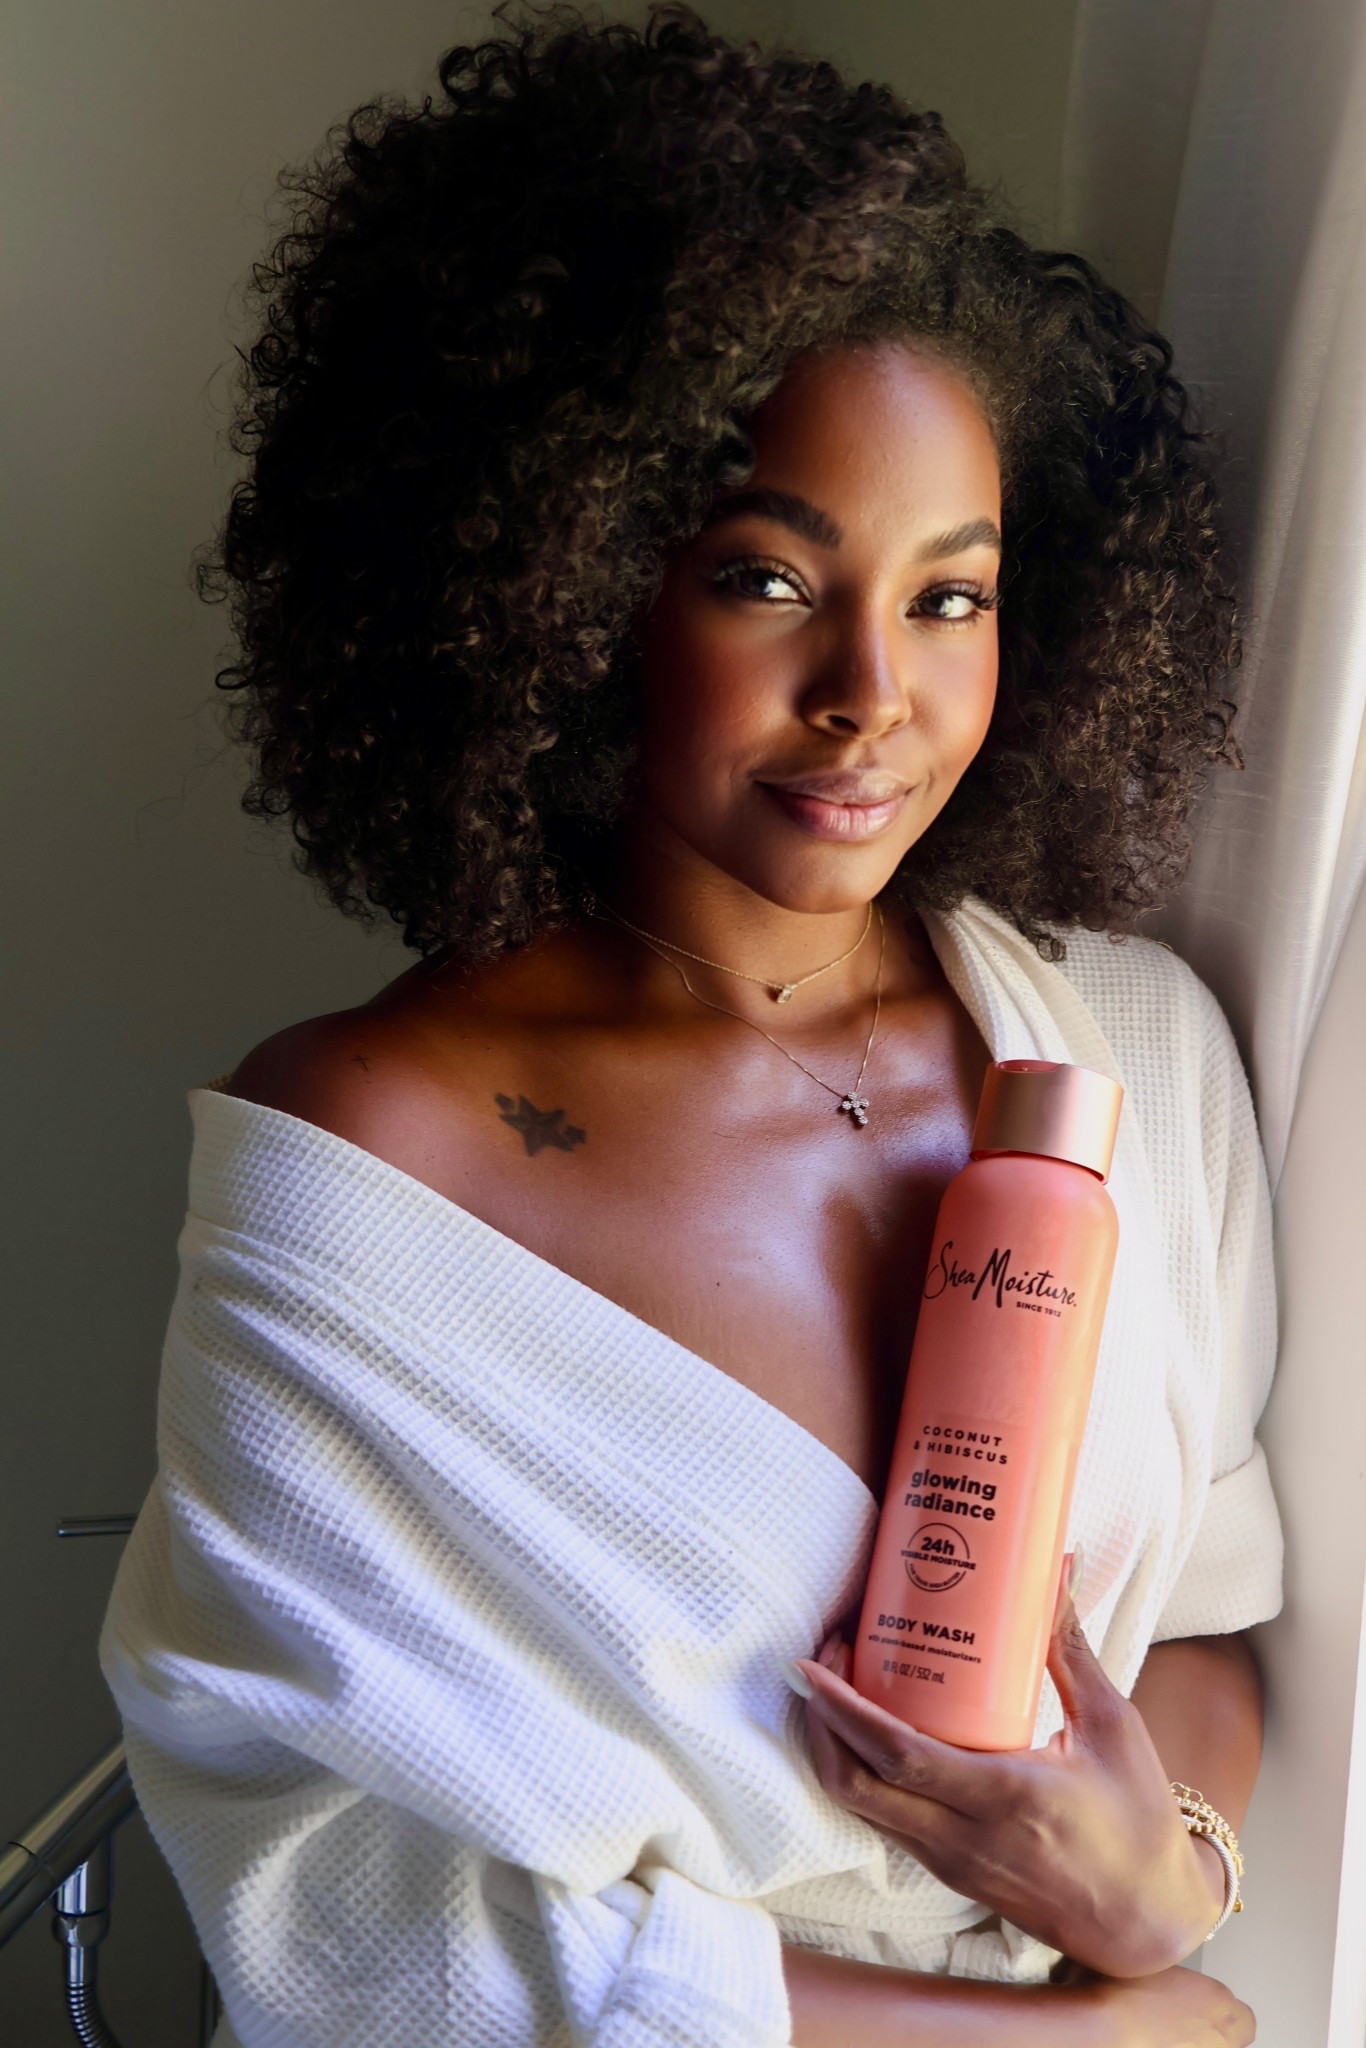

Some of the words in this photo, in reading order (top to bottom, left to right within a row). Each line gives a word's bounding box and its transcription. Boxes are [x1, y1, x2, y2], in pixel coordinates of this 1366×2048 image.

[1016, 1301, 1042, 1313] SINCE
[1044, 1307, 1061, 1317] 1912
[923, 1426, 1002, 1447] COCONUT
[913, 1440, 920, 1450] &
[927, 1442, 1008, 1465] HIBISCUS
[911, 1469, 997, 1501] glowing
[904, 1493, 996, 1521] radiance
[921, 1537, 954, 1556] 24h
[901, 1550, 929, 1561] VISIBLE
[930, 1555, 976, 1571] MOISTURE
[878, 1614, 917, 1632] BODY
[922, 1622, 975, 1645] WASH
[927, 1645, 981, 1664] moisturizers
